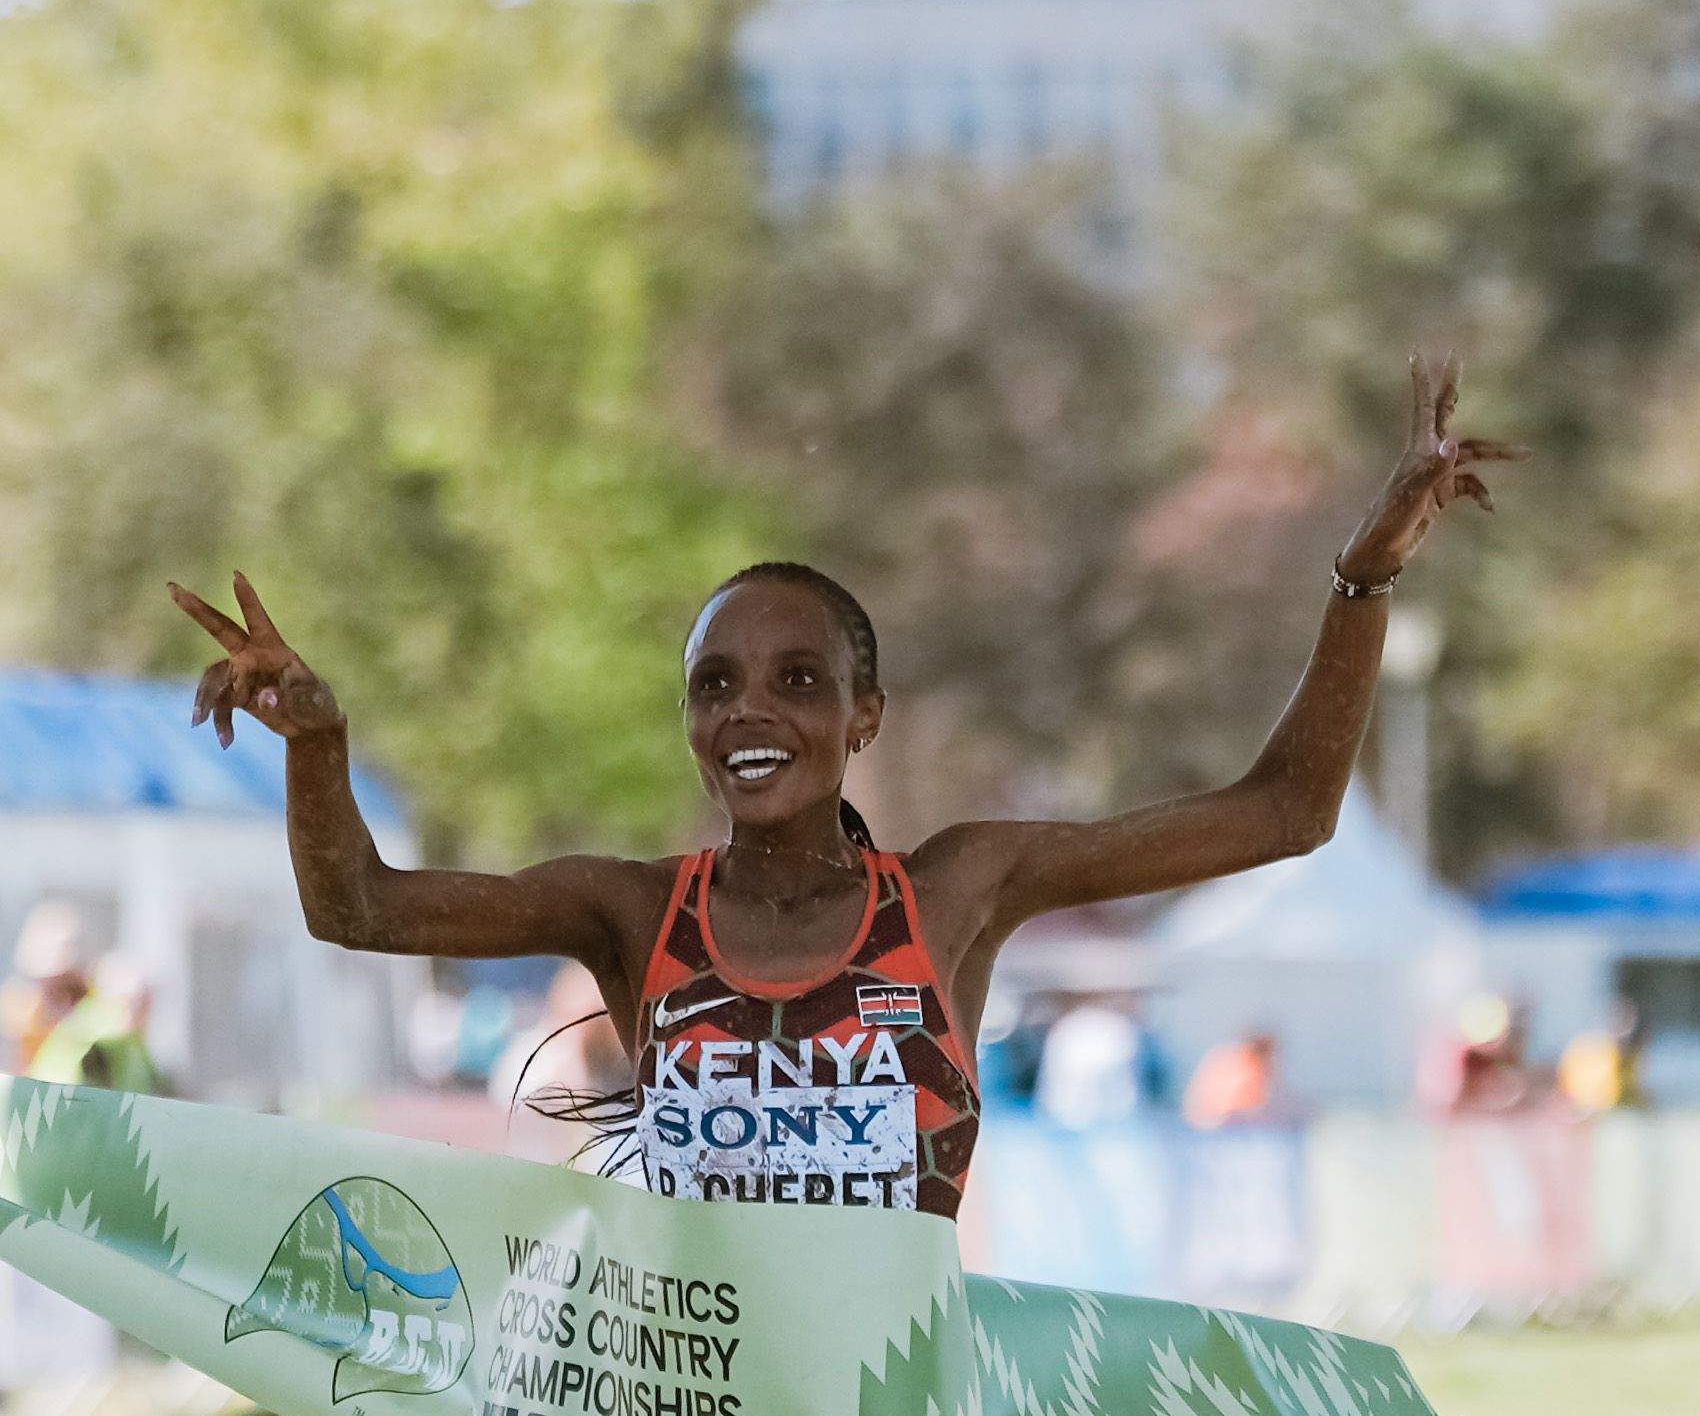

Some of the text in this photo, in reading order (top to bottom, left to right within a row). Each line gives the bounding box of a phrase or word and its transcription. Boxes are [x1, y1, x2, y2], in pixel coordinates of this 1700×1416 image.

[656, 1030, 907, 1090] KENYA
[652, 1104, 887, 1150] SONY
[505, 1234, 741, 1325] WORLD ATHLETICS
[499, 1288, 741, 1382] CROSS COUNTRY
